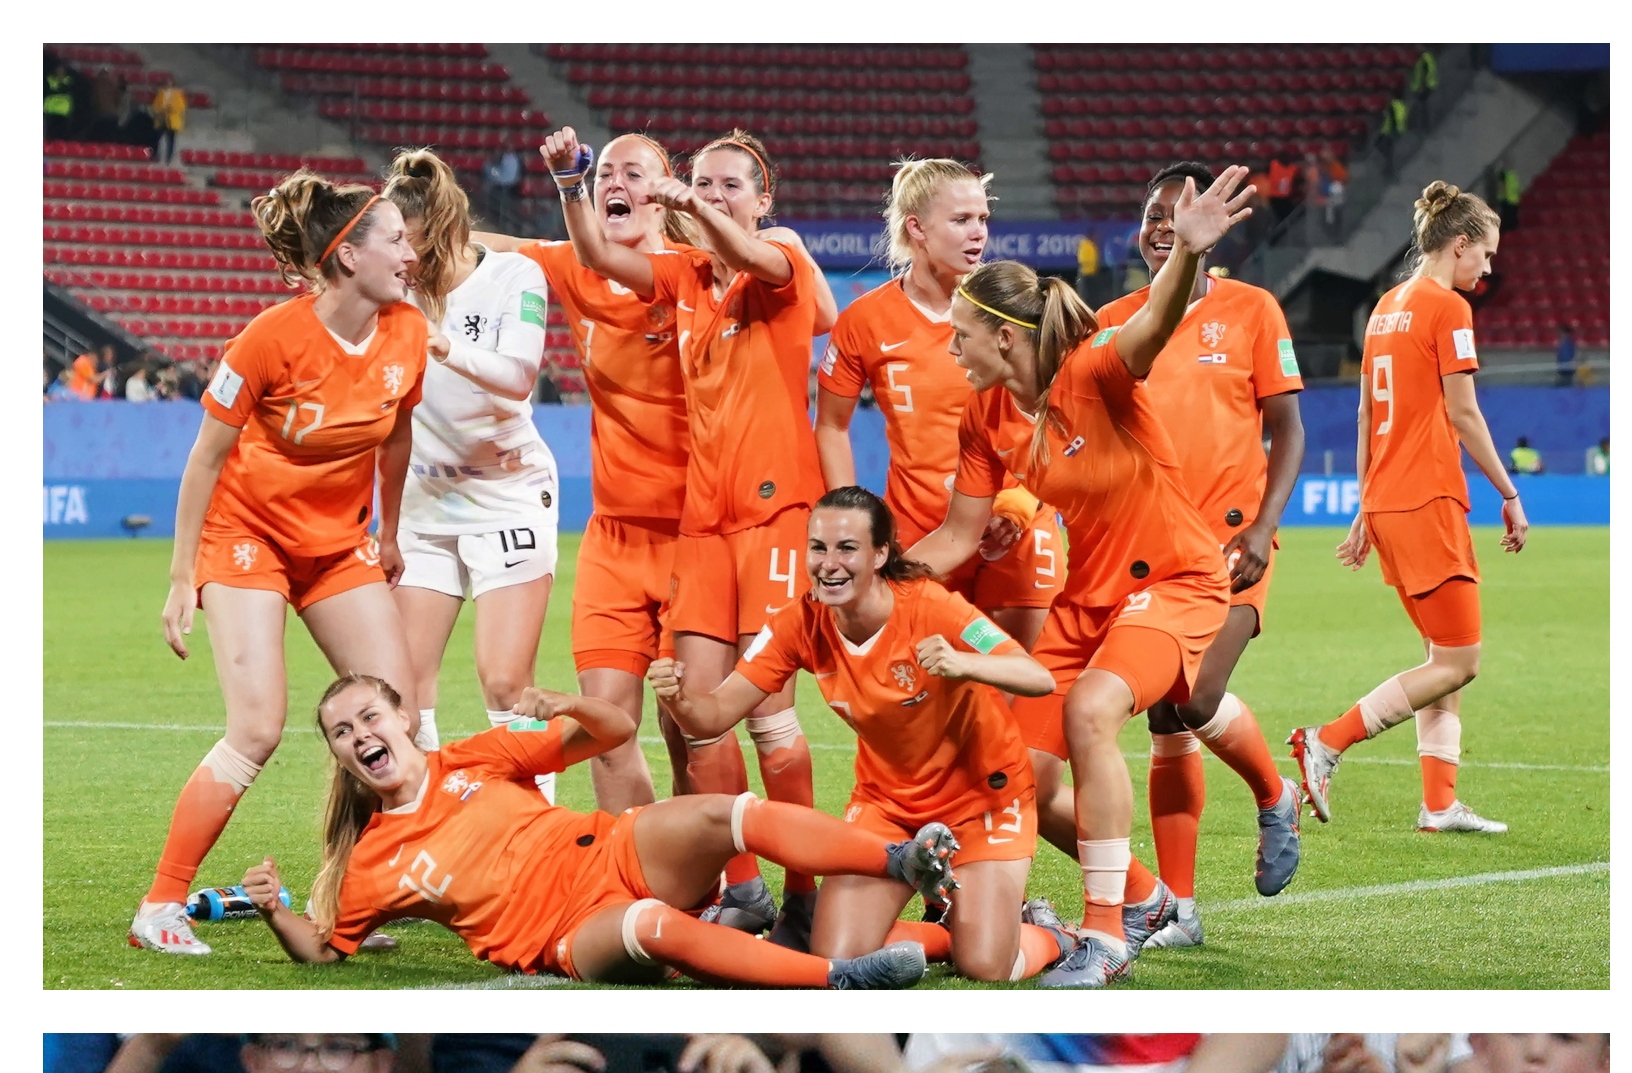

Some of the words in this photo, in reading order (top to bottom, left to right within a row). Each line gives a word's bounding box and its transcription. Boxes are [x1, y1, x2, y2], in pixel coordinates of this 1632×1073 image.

[887, 383, 914, 413] 5
[1372, 354, 1394, 436] 9
[1033, 529, 1056, 577] 5
[768, 567, 797, 599] 4
[984, 797, 1023, 834] 13
